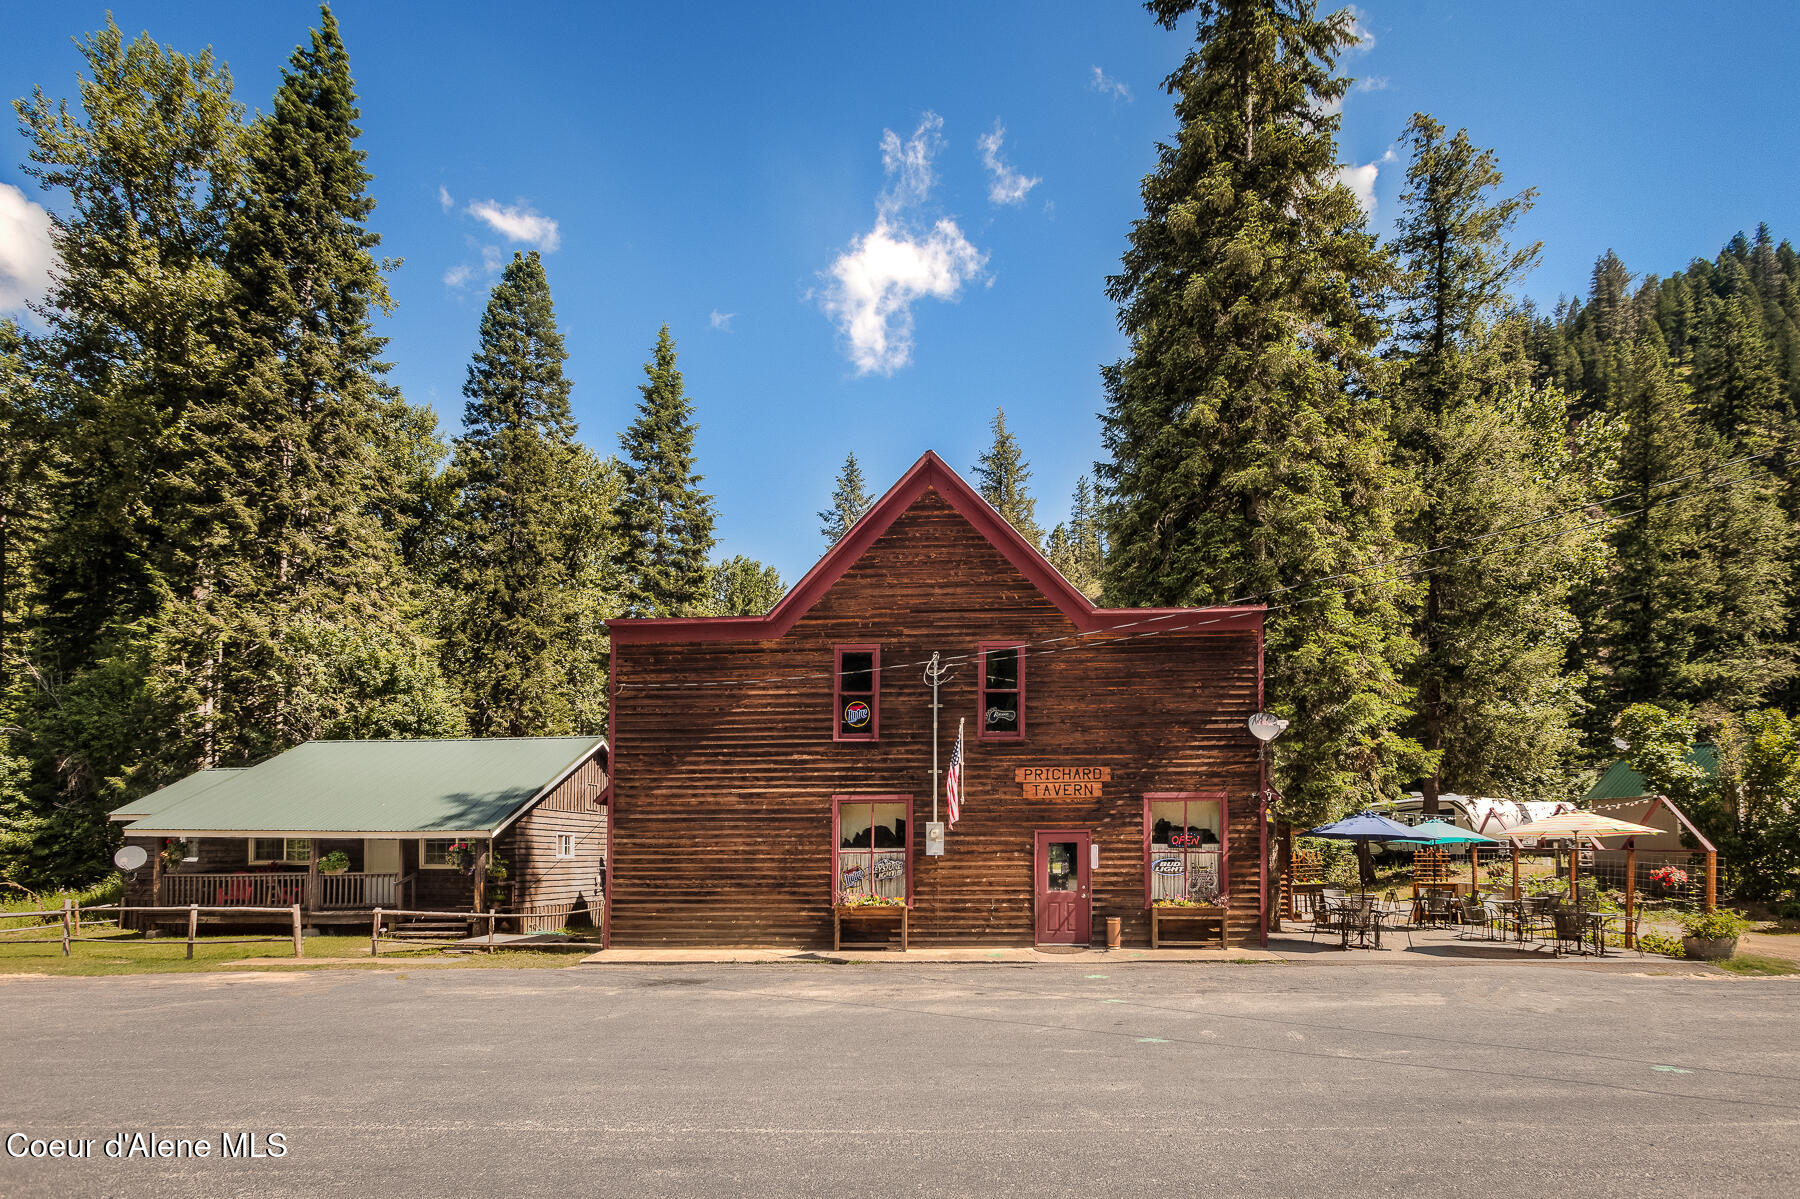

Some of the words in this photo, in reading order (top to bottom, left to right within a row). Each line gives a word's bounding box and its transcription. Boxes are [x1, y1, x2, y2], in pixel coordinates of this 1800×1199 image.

[1024, 768, 1103, 781] PRICHARD
[1032, 784, 1093, 796] TAVERN
[1171, 835, 1200, 845] OPEN
